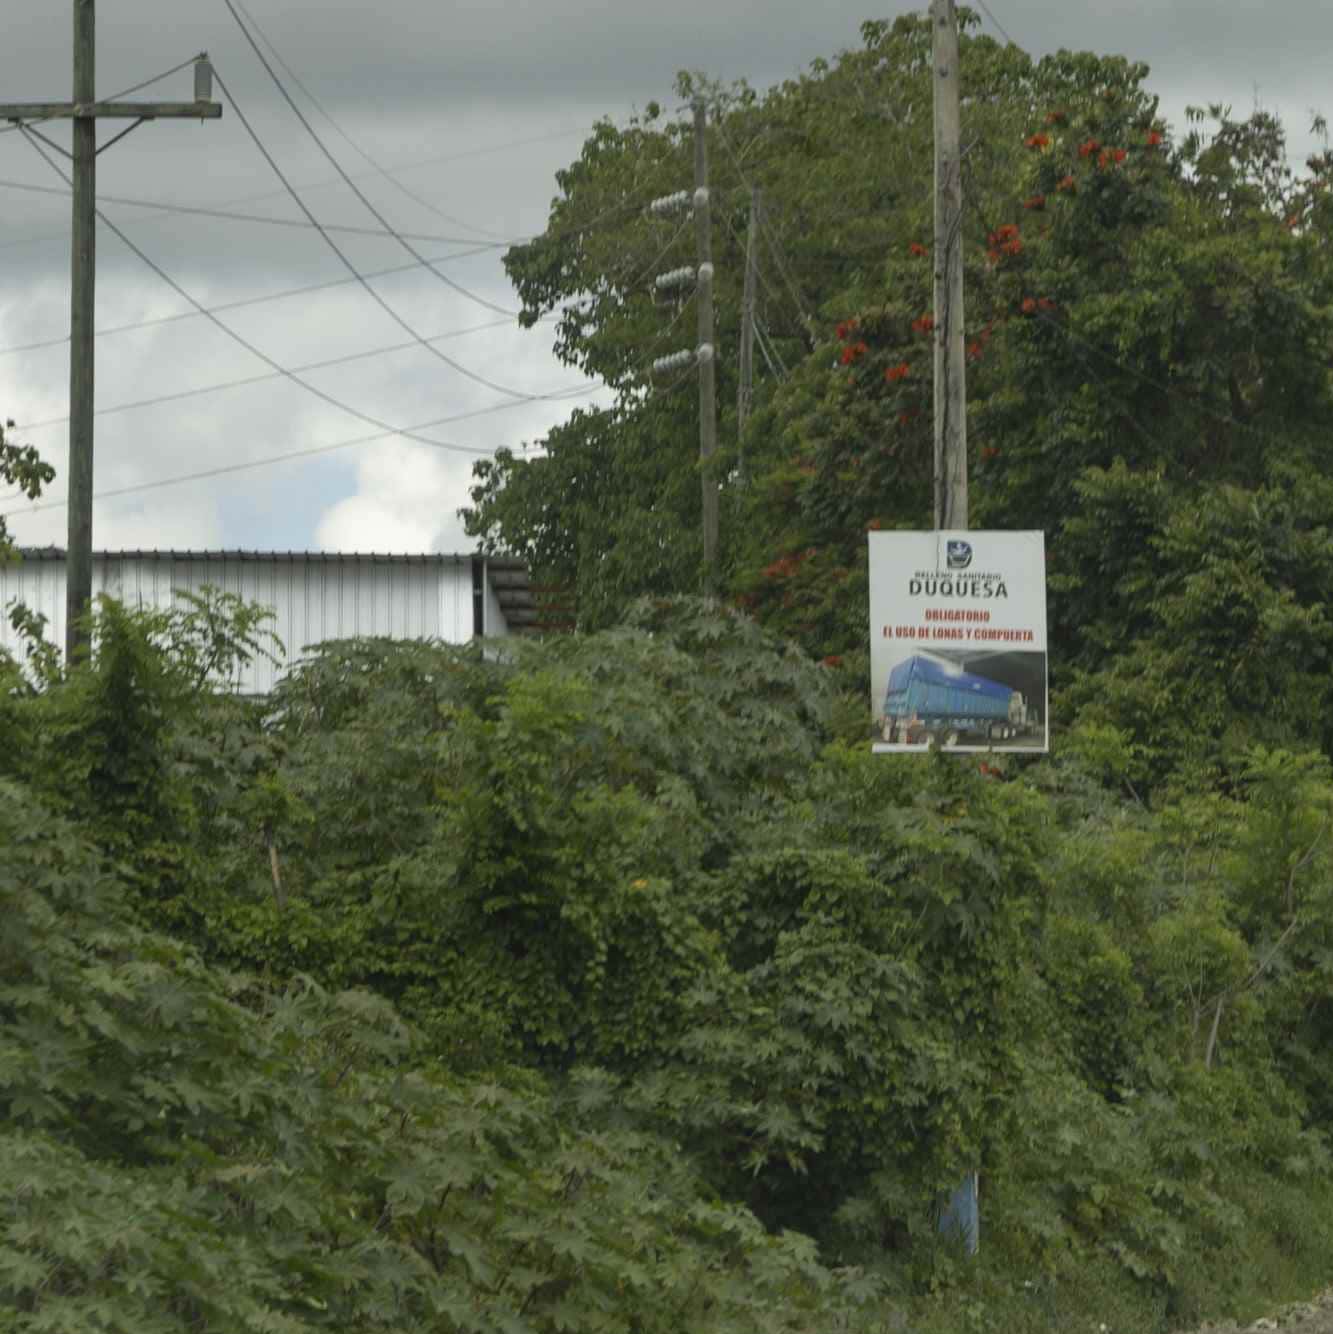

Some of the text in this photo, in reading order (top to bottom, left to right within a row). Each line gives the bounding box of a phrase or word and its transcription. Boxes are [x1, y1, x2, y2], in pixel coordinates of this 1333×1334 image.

[909, 579, 1008, 599] DUQUESA
[925, 608, 990, 622] OBLIGATORIO
[882, 625, 1034, 642] EL USO DE LONAS Y COMPUERTA
